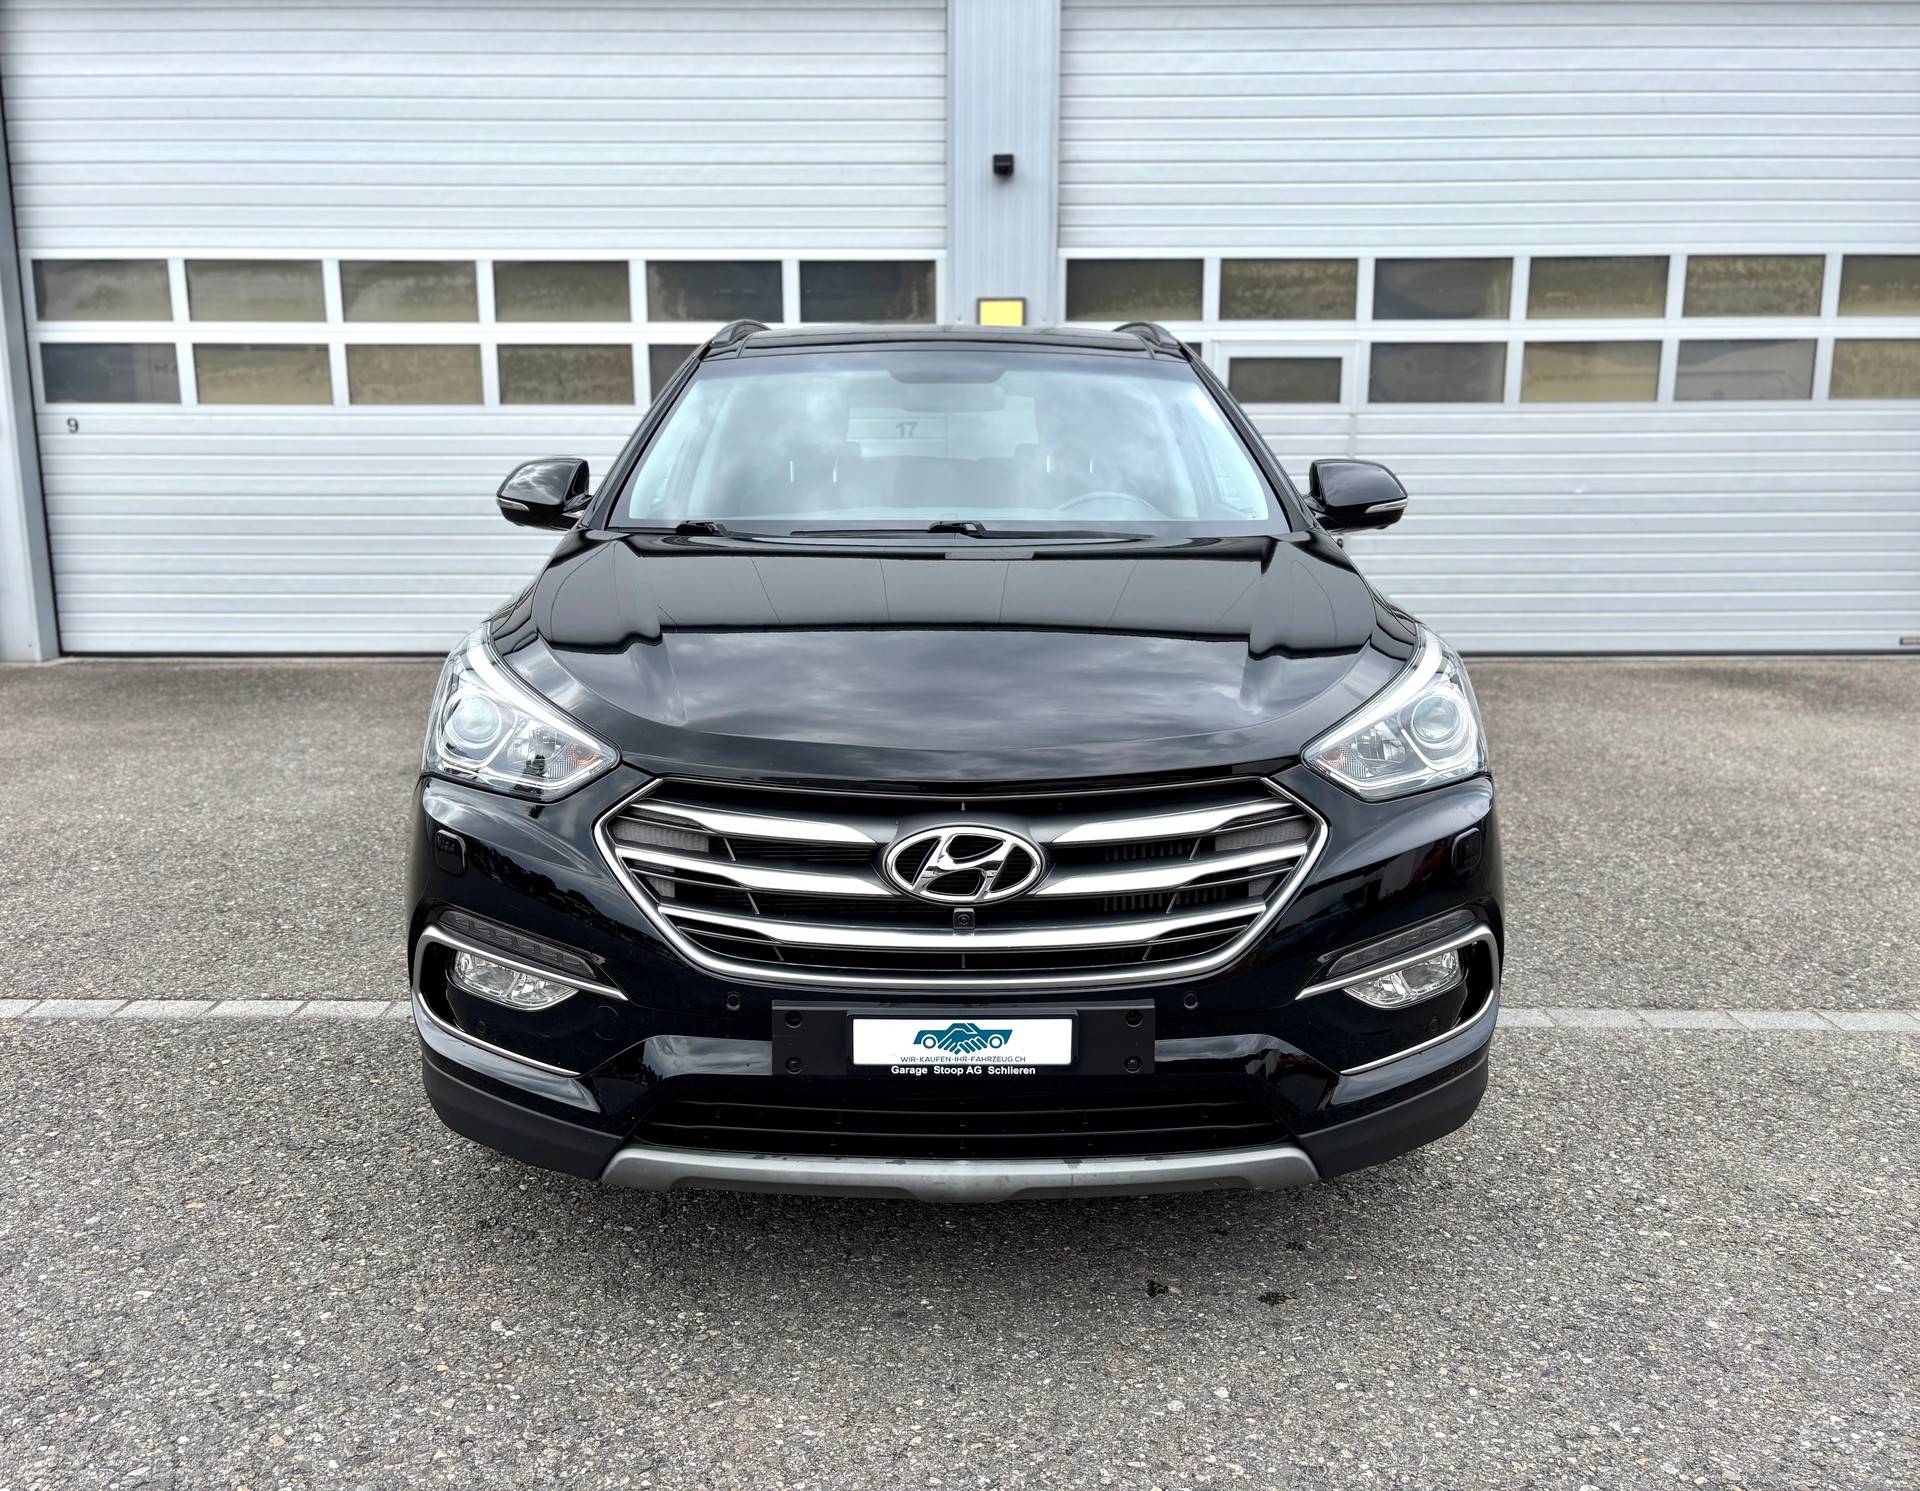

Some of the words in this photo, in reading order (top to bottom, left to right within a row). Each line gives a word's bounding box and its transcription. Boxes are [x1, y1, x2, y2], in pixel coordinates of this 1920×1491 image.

[66, 417, 79, 434] 9
[896, 421, 918, 438] 17
[890, 1065, 928, 1076] Garage
[933, 1065, 964, 1076] Stoop
[966, 1065, 982, 1075] AG
[987, 1065, 1036, 1075] Schlieren
